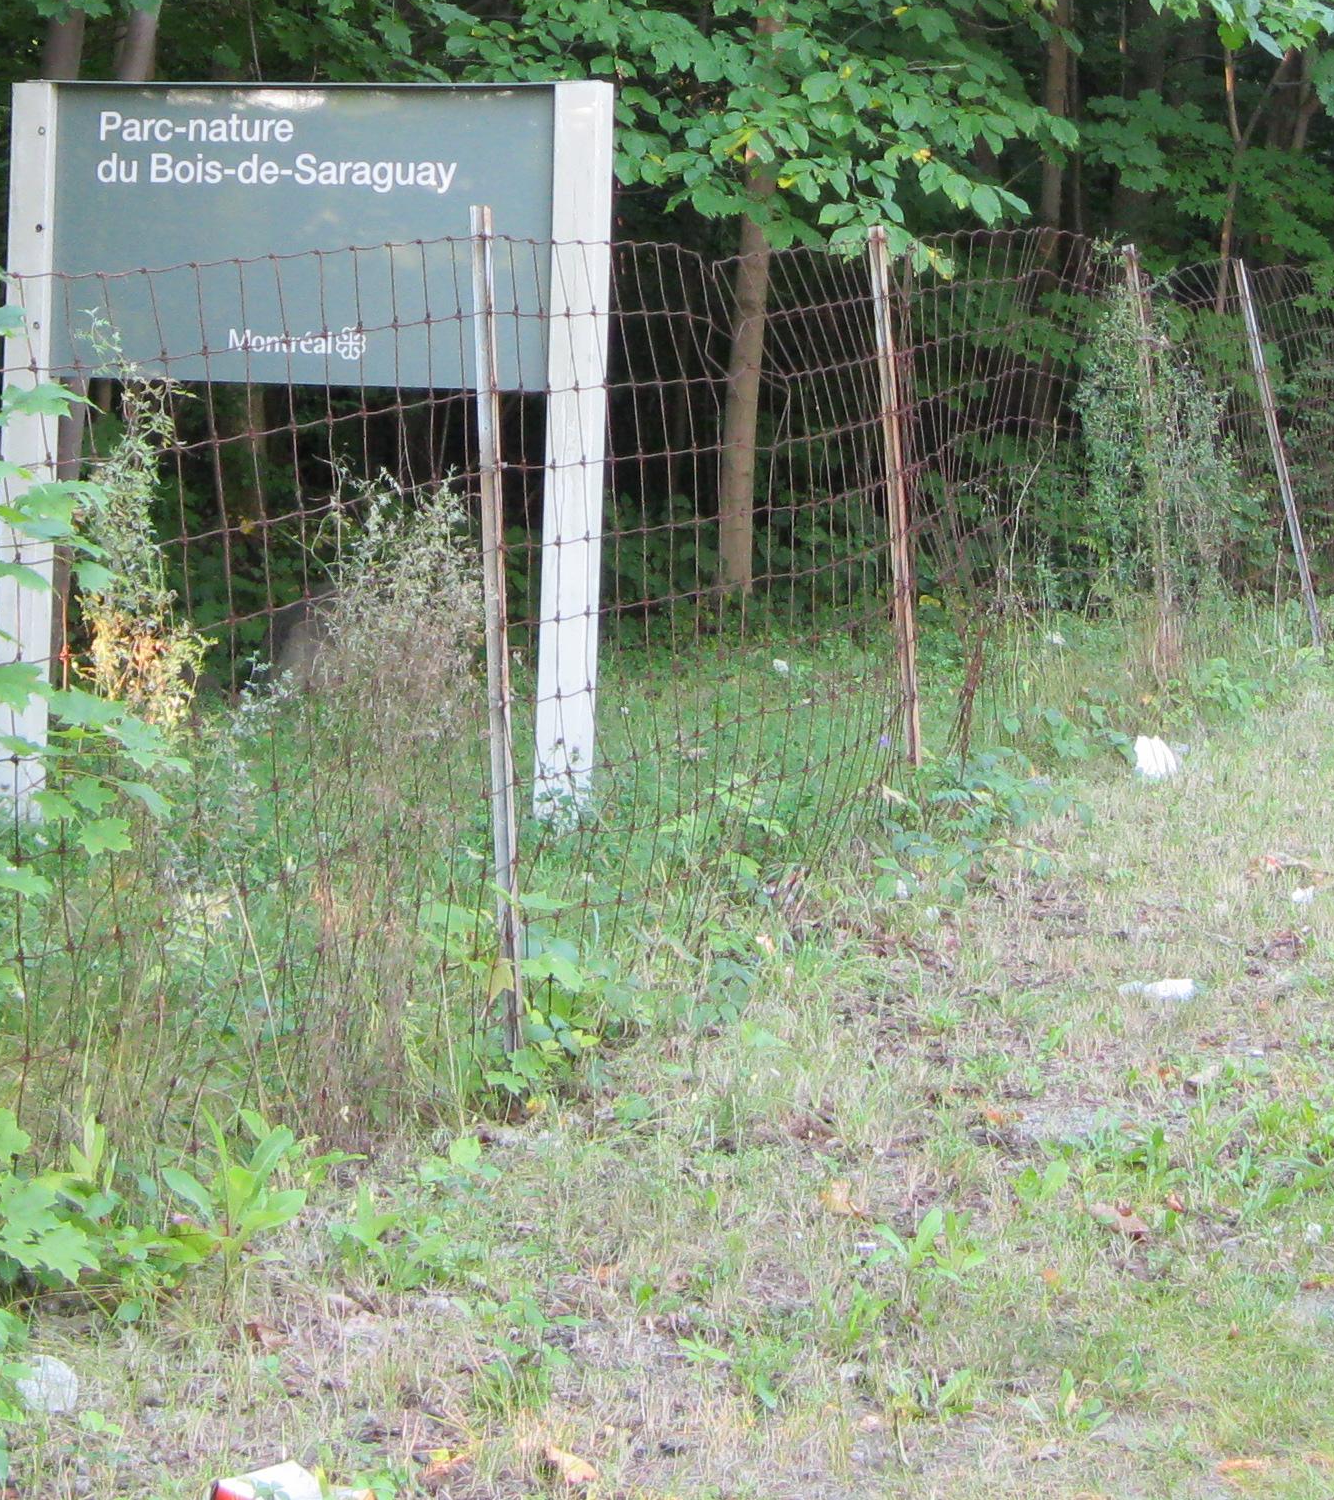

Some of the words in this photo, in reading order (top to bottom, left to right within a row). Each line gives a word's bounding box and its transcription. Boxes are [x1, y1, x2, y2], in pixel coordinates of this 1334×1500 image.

[99, 111, 294, 143] Parc-nature
[97, 152, 138, 183] du
[150, 152, 457, 194] Bois-de-Saraguay
[228, 328, 333, 354] Montréal
